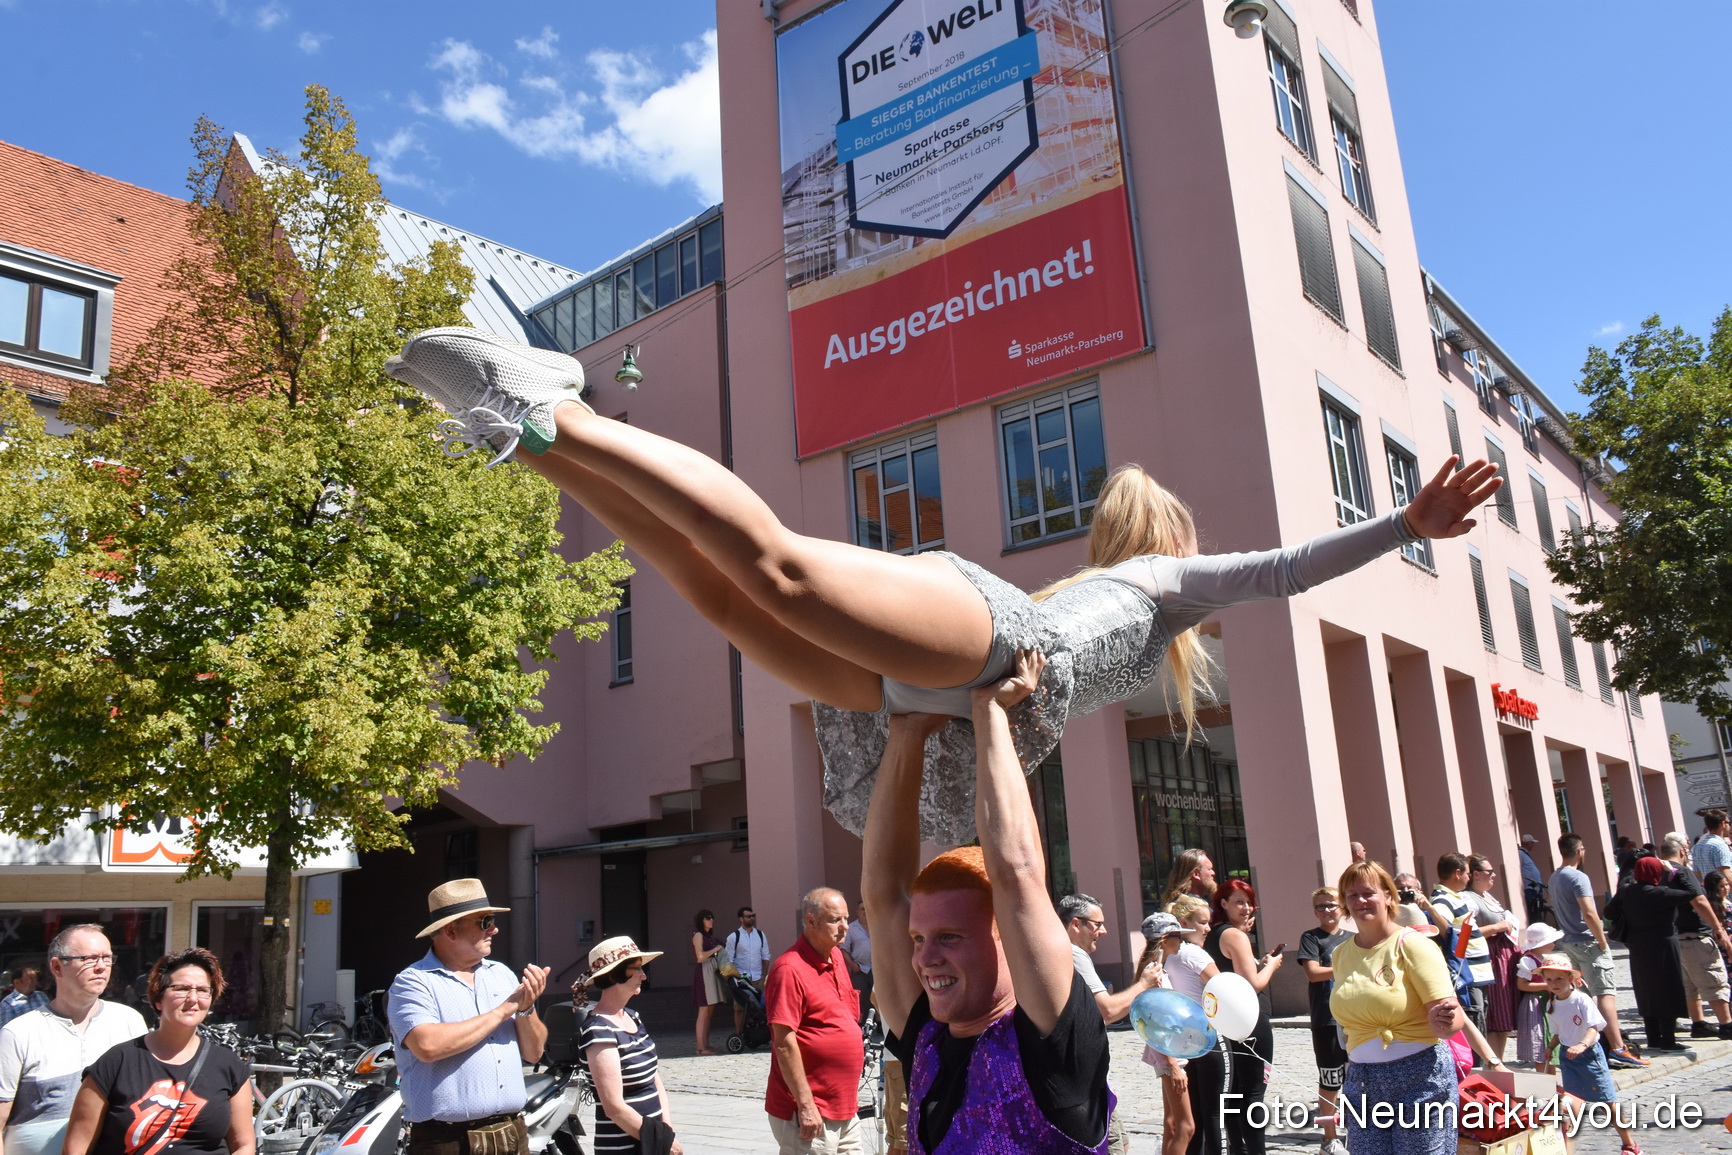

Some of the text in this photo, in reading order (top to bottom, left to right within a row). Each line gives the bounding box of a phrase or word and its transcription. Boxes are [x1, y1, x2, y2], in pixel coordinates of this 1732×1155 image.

[851, 45, 896, 85] DIE
[898, 51, 965, 91] September 2018
[854, 65, 1019, 151] Beratung Baufinanzierung
[871, 57, 997, 127] SIEGER BANKENTEST
[875, 120, 1004, 186] Neumarkt-Parsberg
[904, 118, 970, 156] Sparkasse
[885, 178, 916, 197] Banken
[917, 173, 925, 183] in
[926, 152, 968, 178] Neumarkt
[900, 172, 984, 215] Internationales Institut für
[951, 186, 974, 201] GmbH
[823, 239, 1095, 370] Ausgezeichnet!
[1024, 331, 1075, 354] Sparkasse
[1026, 330, 1124, 368] Neumarkt-Parsberg
[1154, 789, 1216, 812] wochenblatt
[1222, 1052, 1231, 1074] NEEDED
